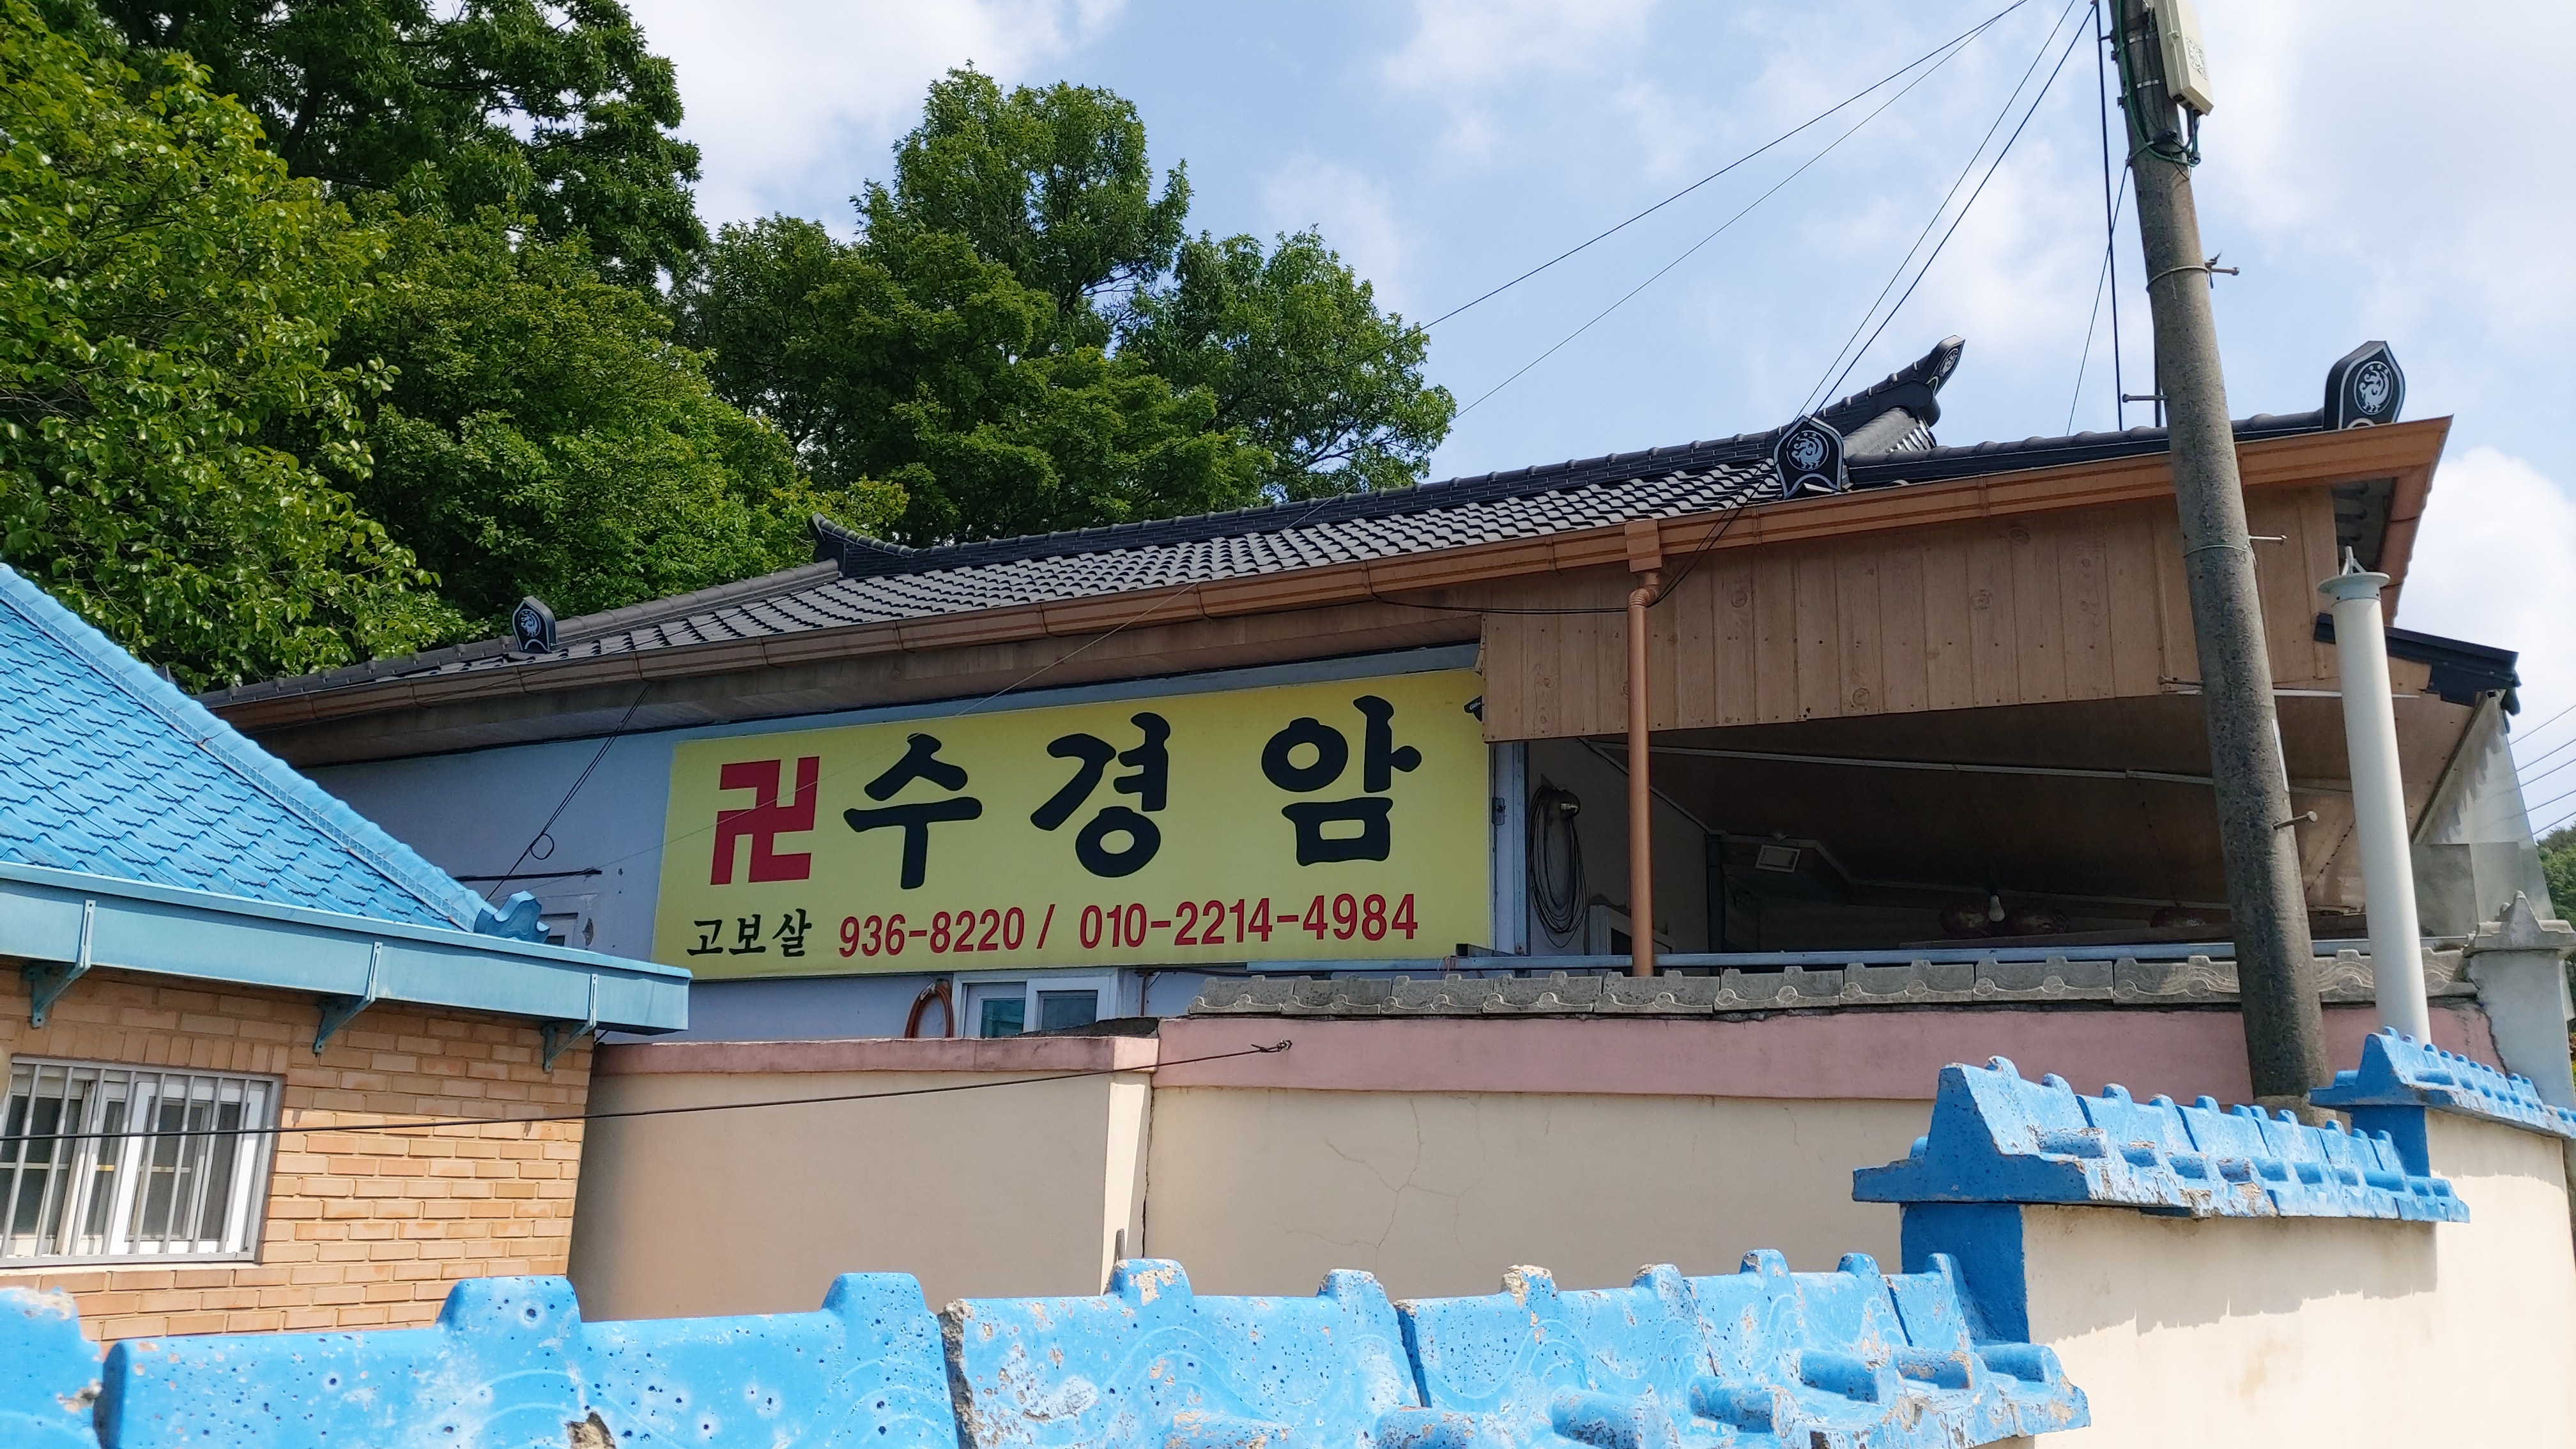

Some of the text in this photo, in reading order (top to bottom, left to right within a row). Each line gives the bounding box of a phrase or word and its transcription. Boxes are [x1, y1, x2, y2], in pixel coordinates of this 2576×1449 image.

[686, 908, 813, 958] 고보살
[838, 907, 1025, 958] 936-8220
[1079, 893, 1419, 949] 010-2214-4984
